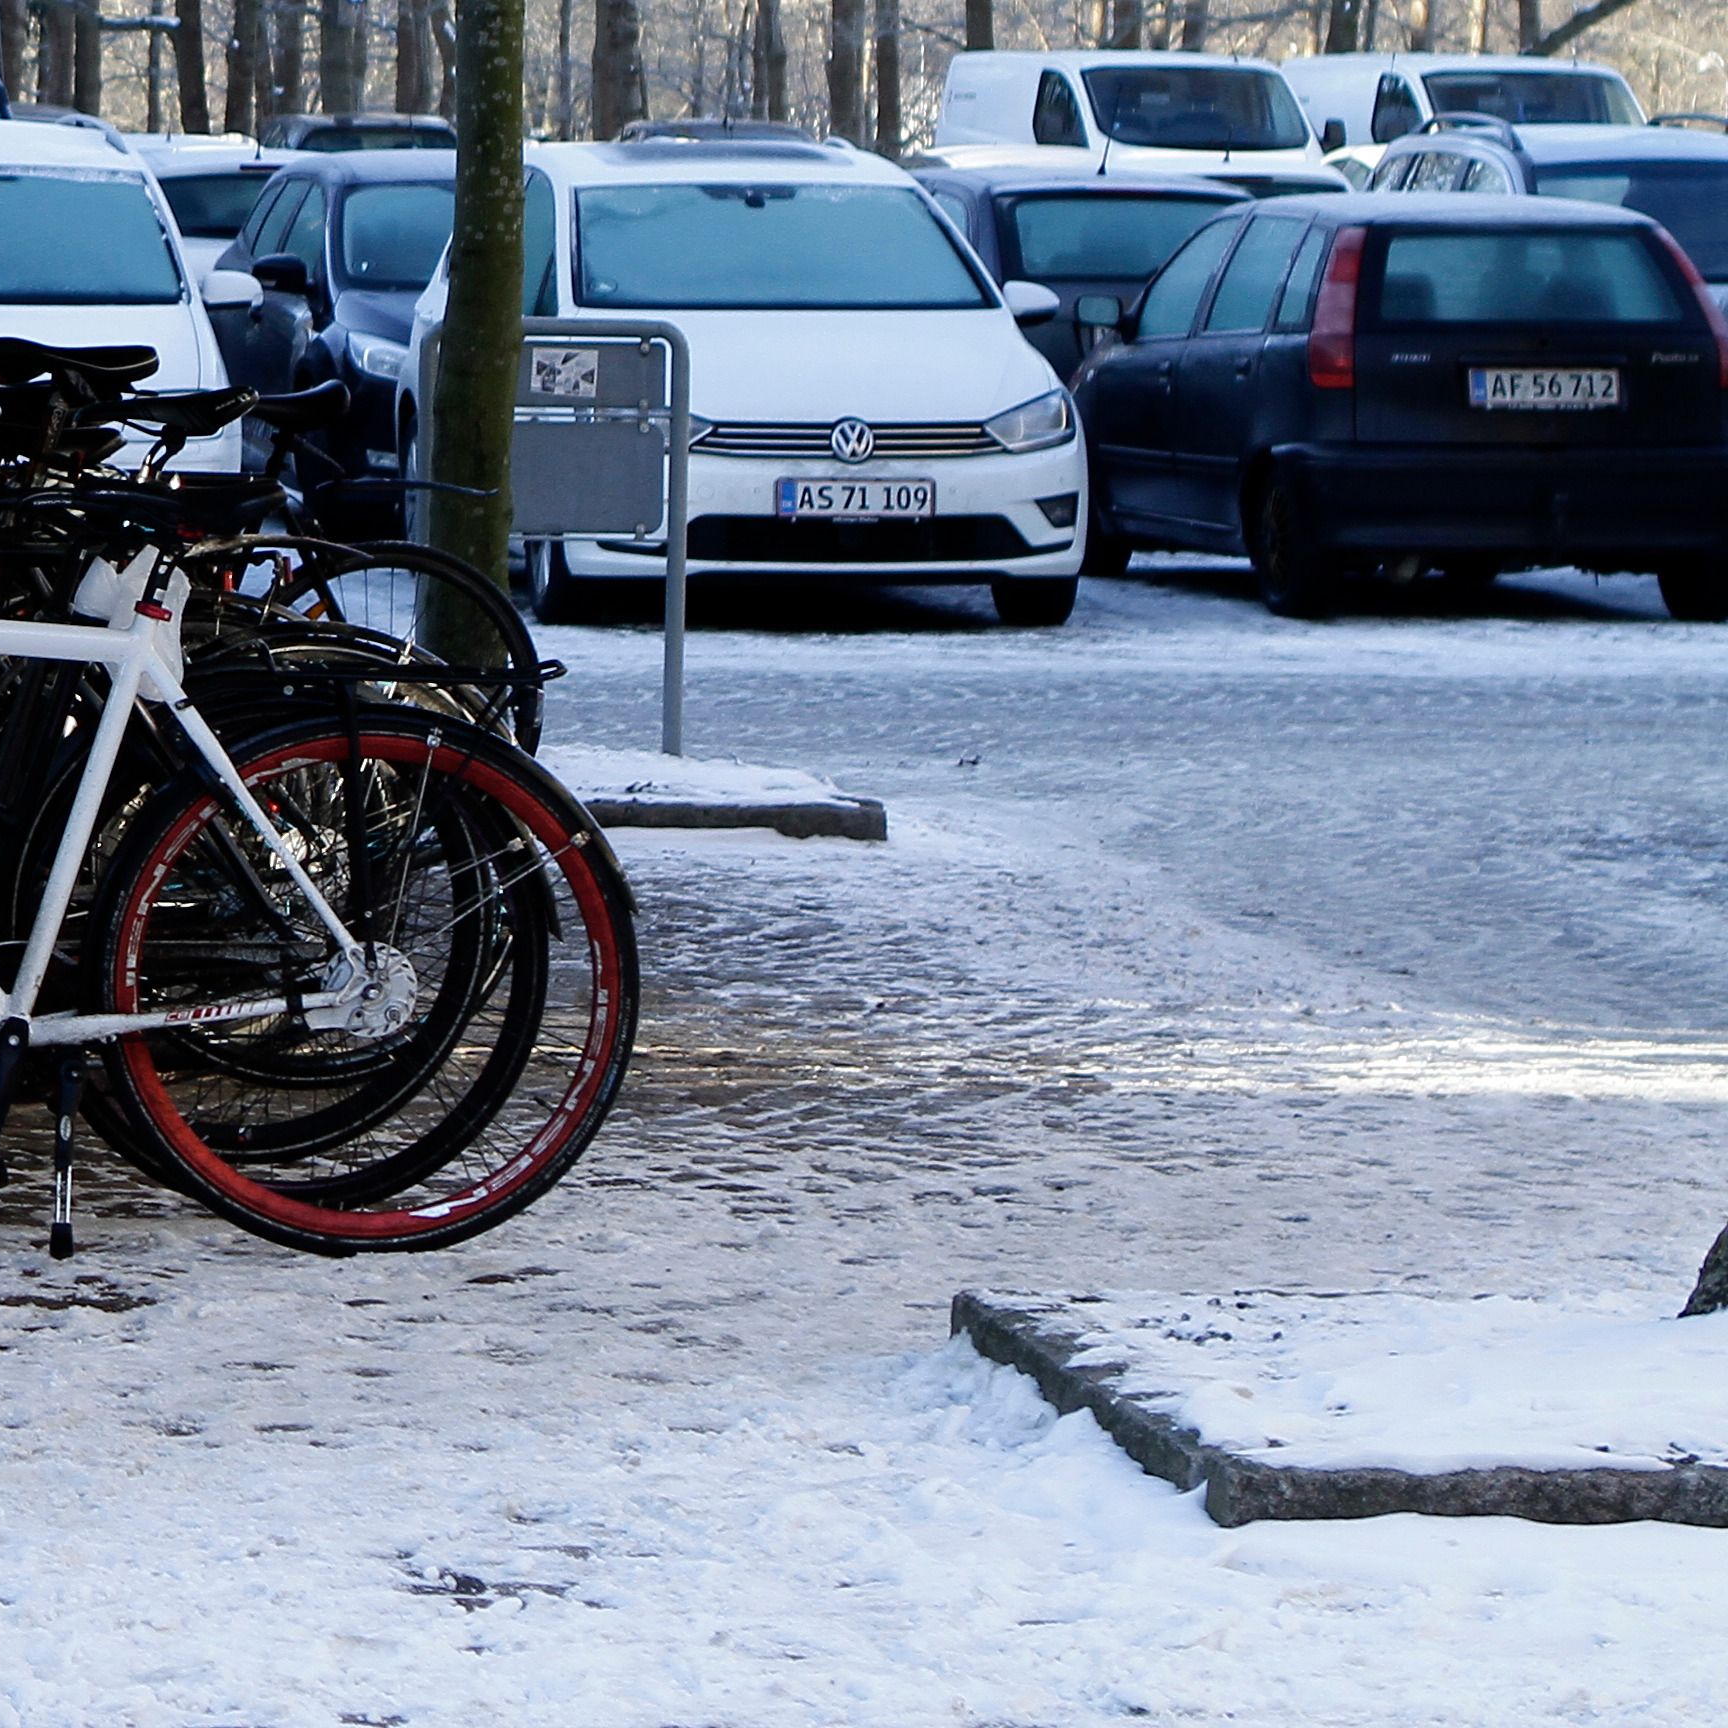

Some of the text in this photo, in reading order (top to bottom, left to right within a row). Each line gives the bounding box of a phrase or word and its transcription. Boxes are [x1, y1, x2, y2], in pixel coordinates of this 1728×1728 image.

[1492, 374, 1615, 399] AF 56 712
[799, 485, 929, 511] AS 71 109
